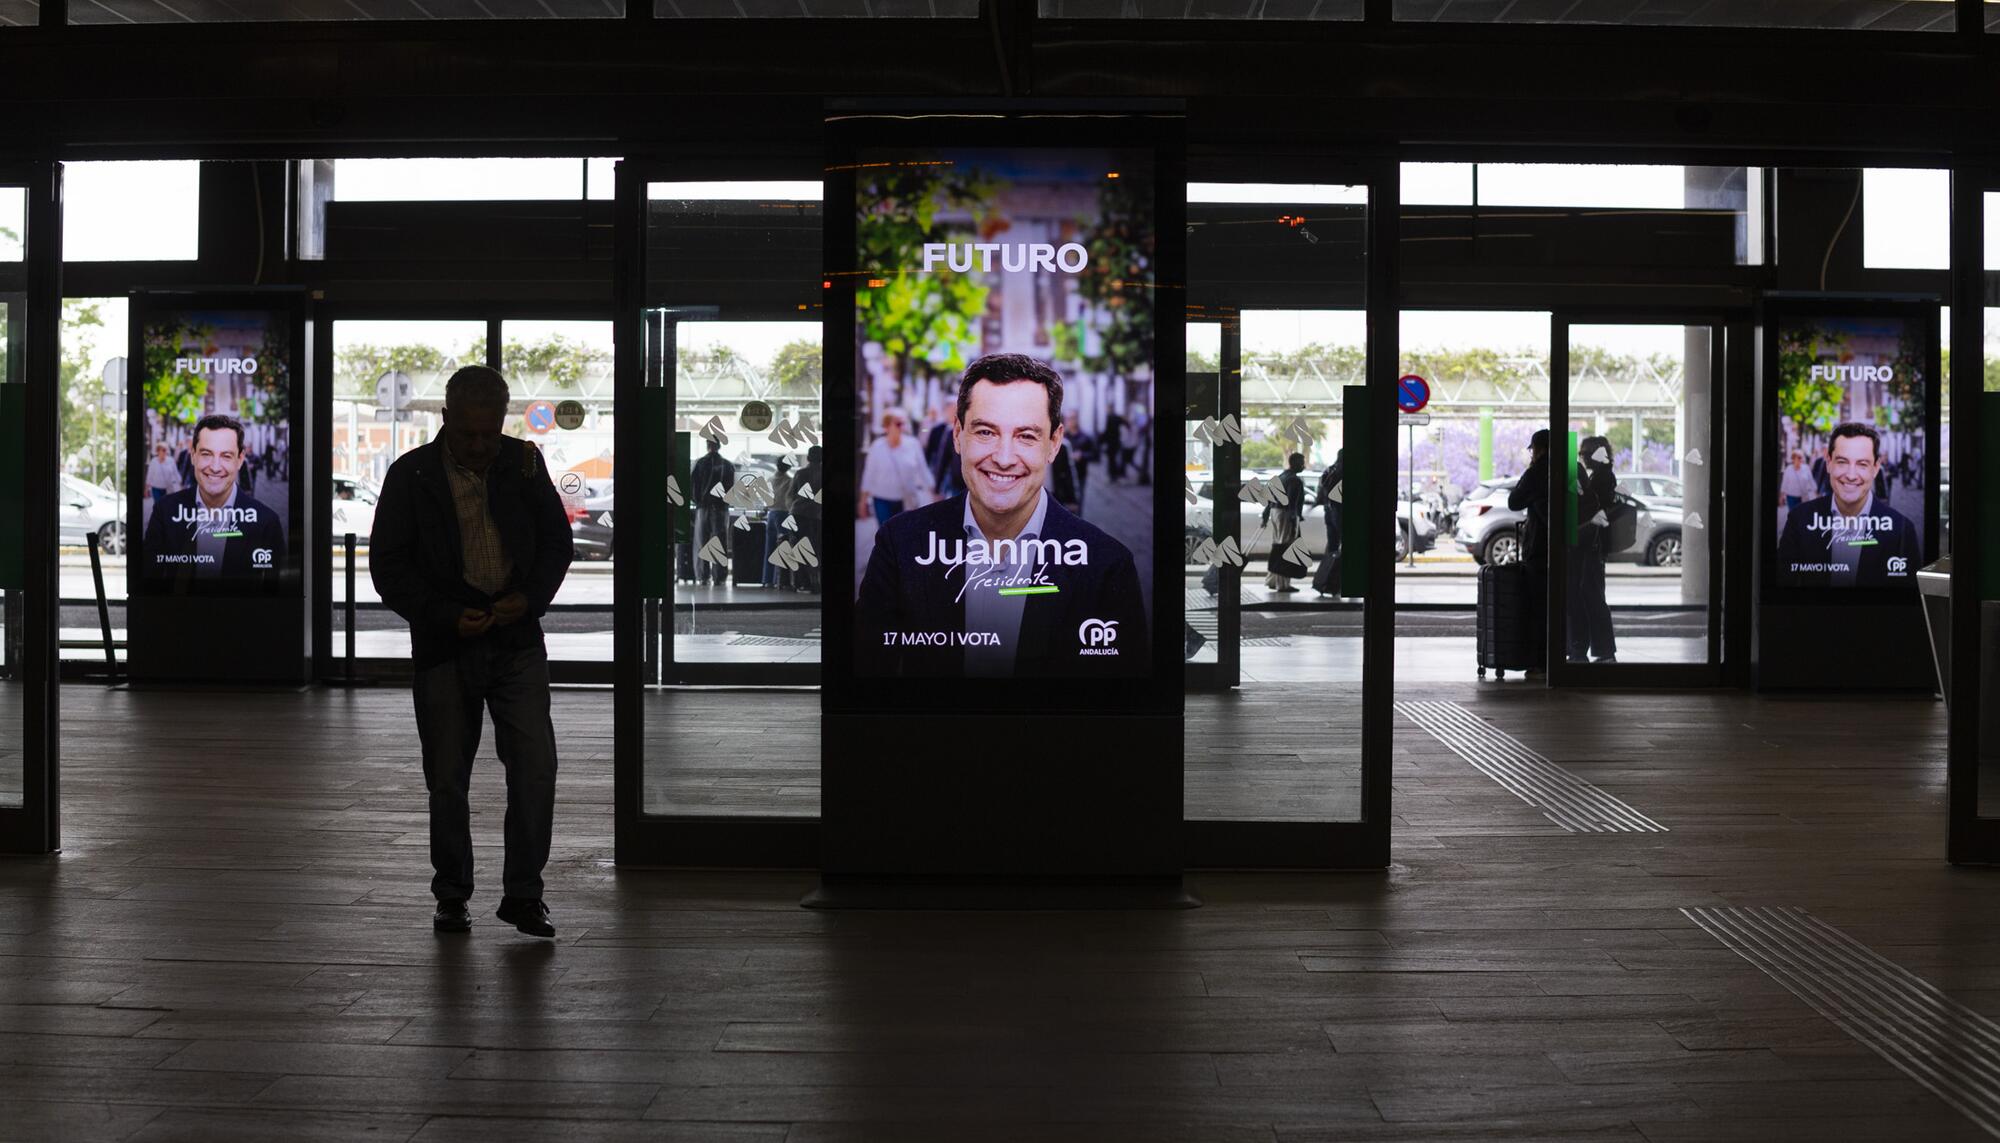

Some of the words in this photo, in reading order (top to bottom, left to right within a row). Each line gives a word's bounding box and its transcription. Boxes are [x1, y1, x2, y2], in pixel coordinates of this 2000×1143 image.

[923, 243, 1088, 274] FUTURO
[175, 358, 258, 375] FUTURO
[1811, 365, 1893, 382] FUTURO
[172, 503, 257, 523] Juanma
[1806, 511, 1893, 531] Juanma
[914, 531, 1088, 566] Juanma
[156, 555, 164, 563] 17
[165, 555, 188, 563] MAYO
[193, 555, 215, 563] VOTA
[1791, 563, 1799, 572] 17
[1800, 563, 1823, 572] MAYO
[1828, 563, 1850, 572] VOTA
[944, 553, 1055, 603] Presidente
[883, 632, 897, 645] 17
[901, 632, 947, 645] MAYO
[957, 632, 1001, 645] VOTA
[1079, 647, 1119, 655] ANDALUCÍA
